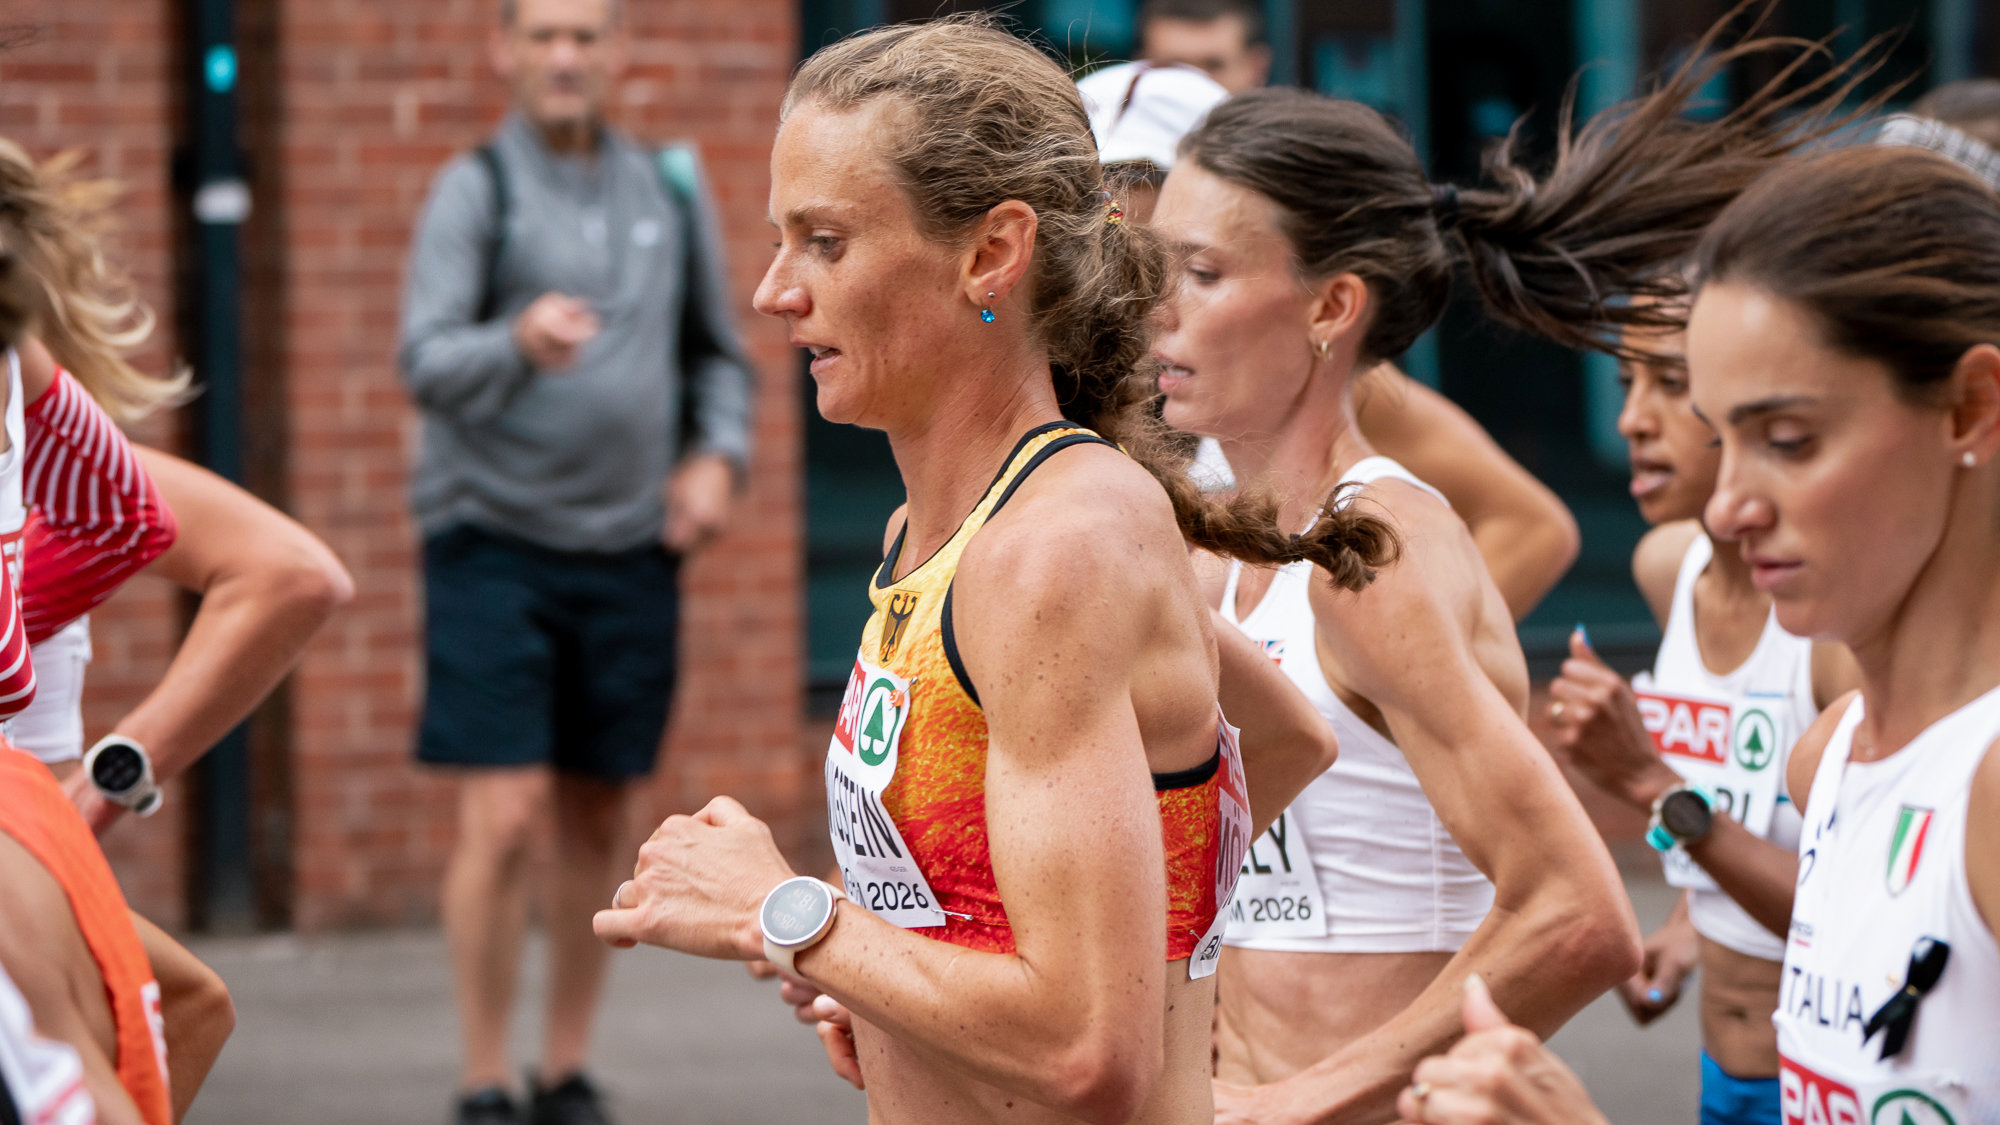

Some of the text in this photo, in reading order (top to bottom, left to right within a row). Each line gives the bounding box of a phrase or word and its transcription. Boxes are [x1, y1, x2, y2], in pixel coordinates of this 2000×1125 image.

[1241, 813, 1292, 874] LY
[867, 881, 929, 911] 2026
[1250, 896, 1311, 921] 2026
